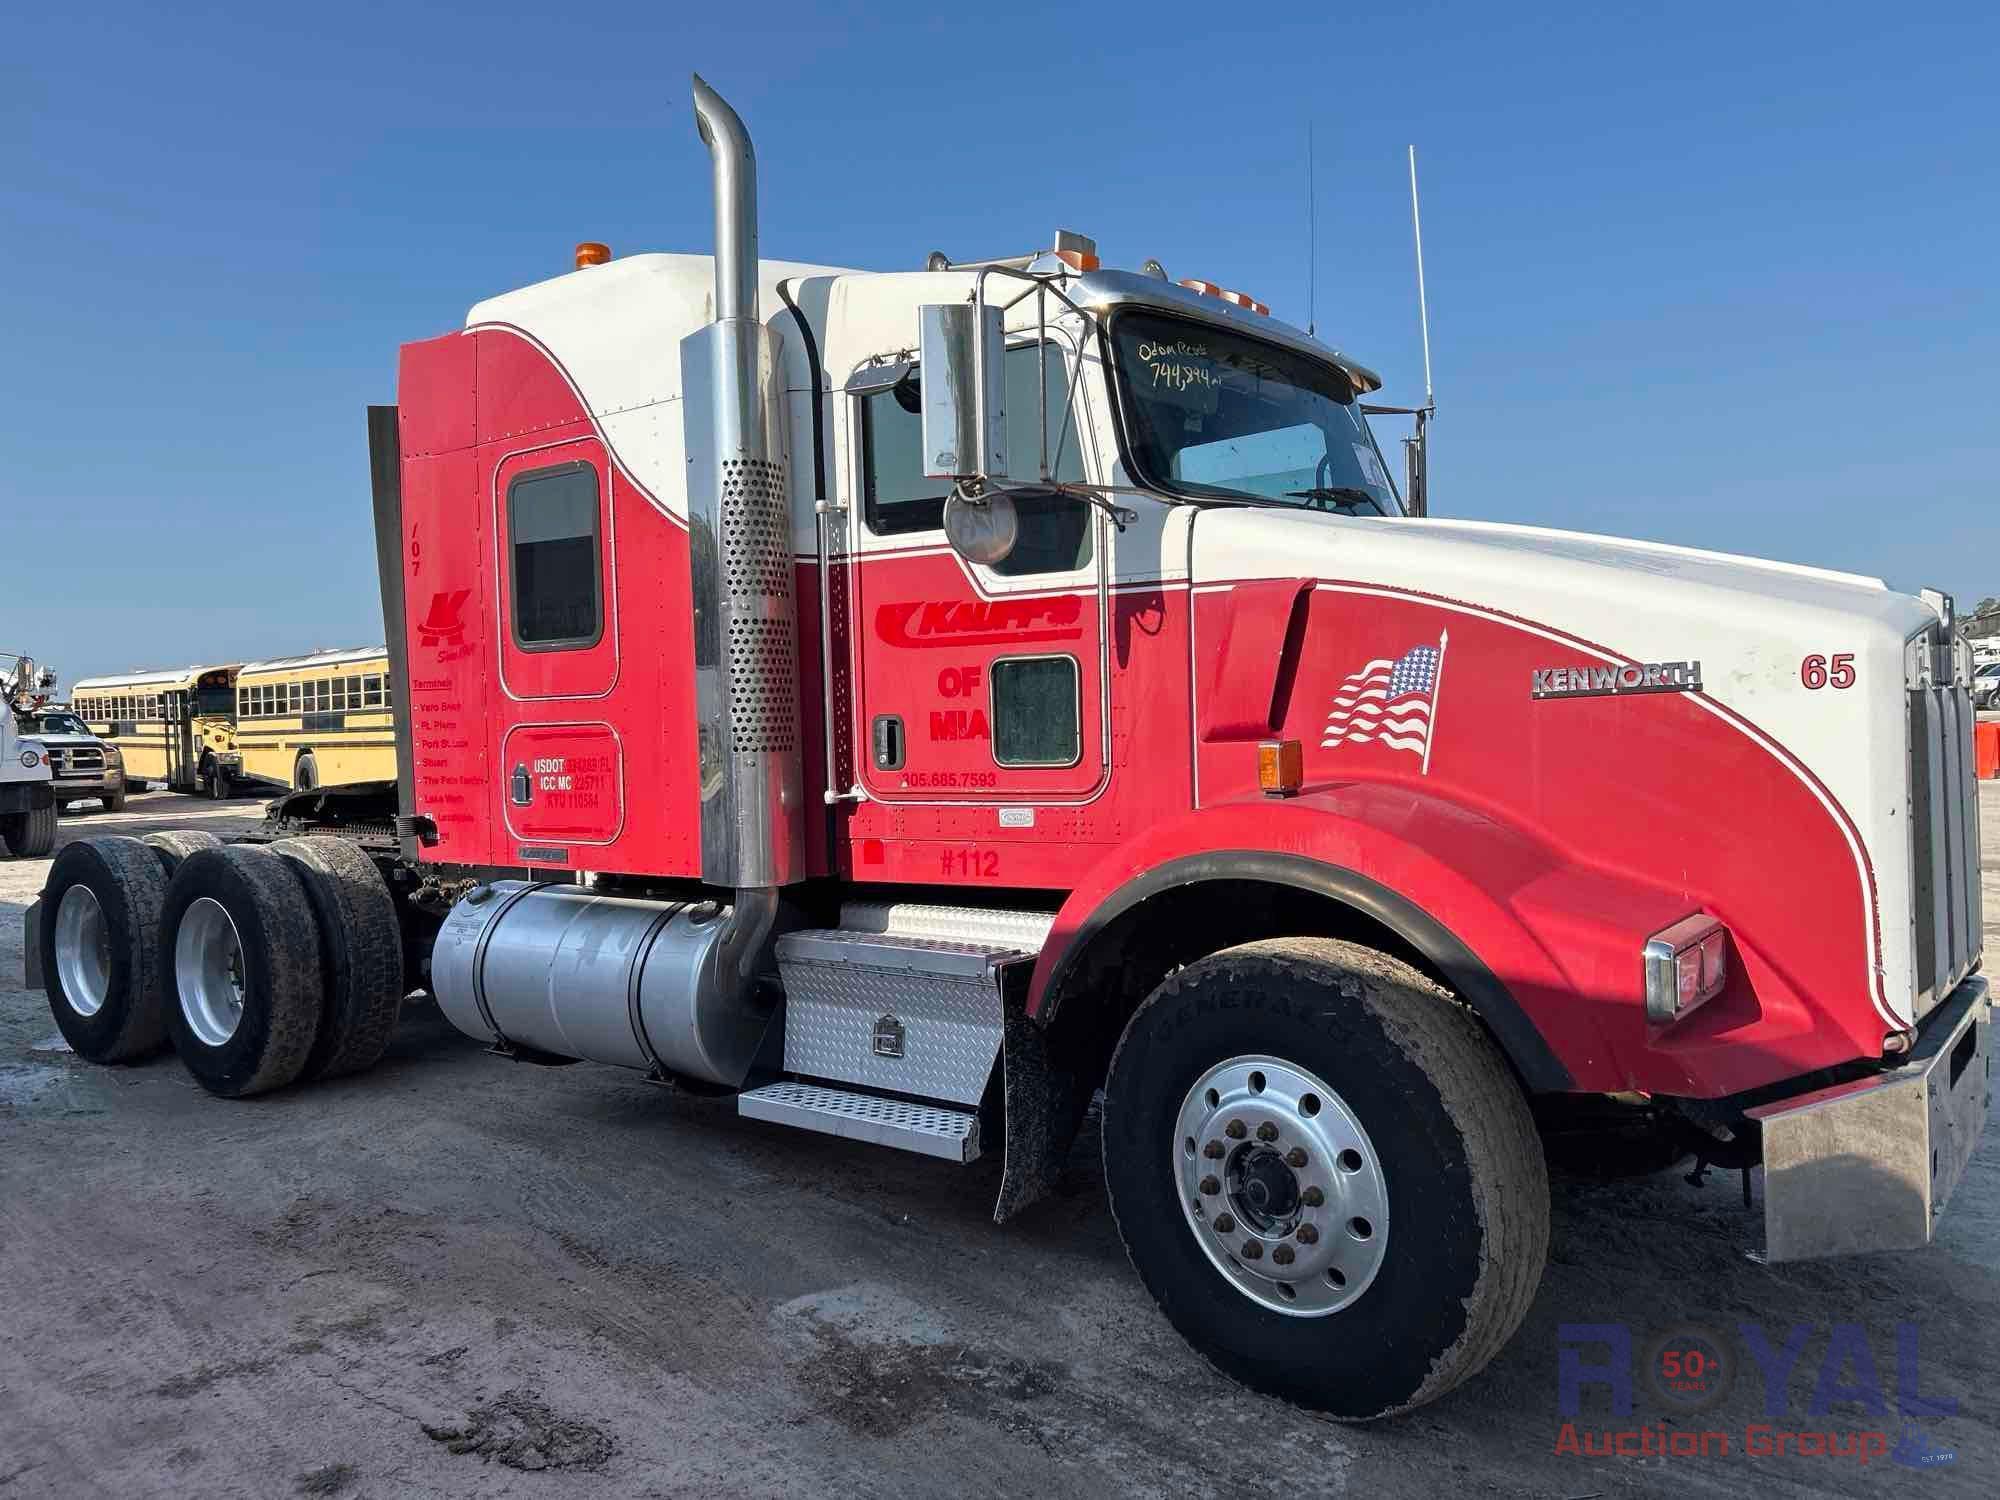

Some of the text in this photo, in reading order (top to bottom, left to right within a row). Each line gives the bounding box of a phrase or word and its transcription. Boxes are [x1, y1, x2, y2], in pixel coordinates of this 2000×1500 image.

[938, 666, 981, 698] OF
[1532, 660, 1702, 693] KENWORTH
[1801, 653, 1856, 690] 65
[534, 758, 564, 773] USDOT
[540, 775, 556, 790] ICC
[558, 775, 572, 790] MC
[941, 849, 999, 877] #112
